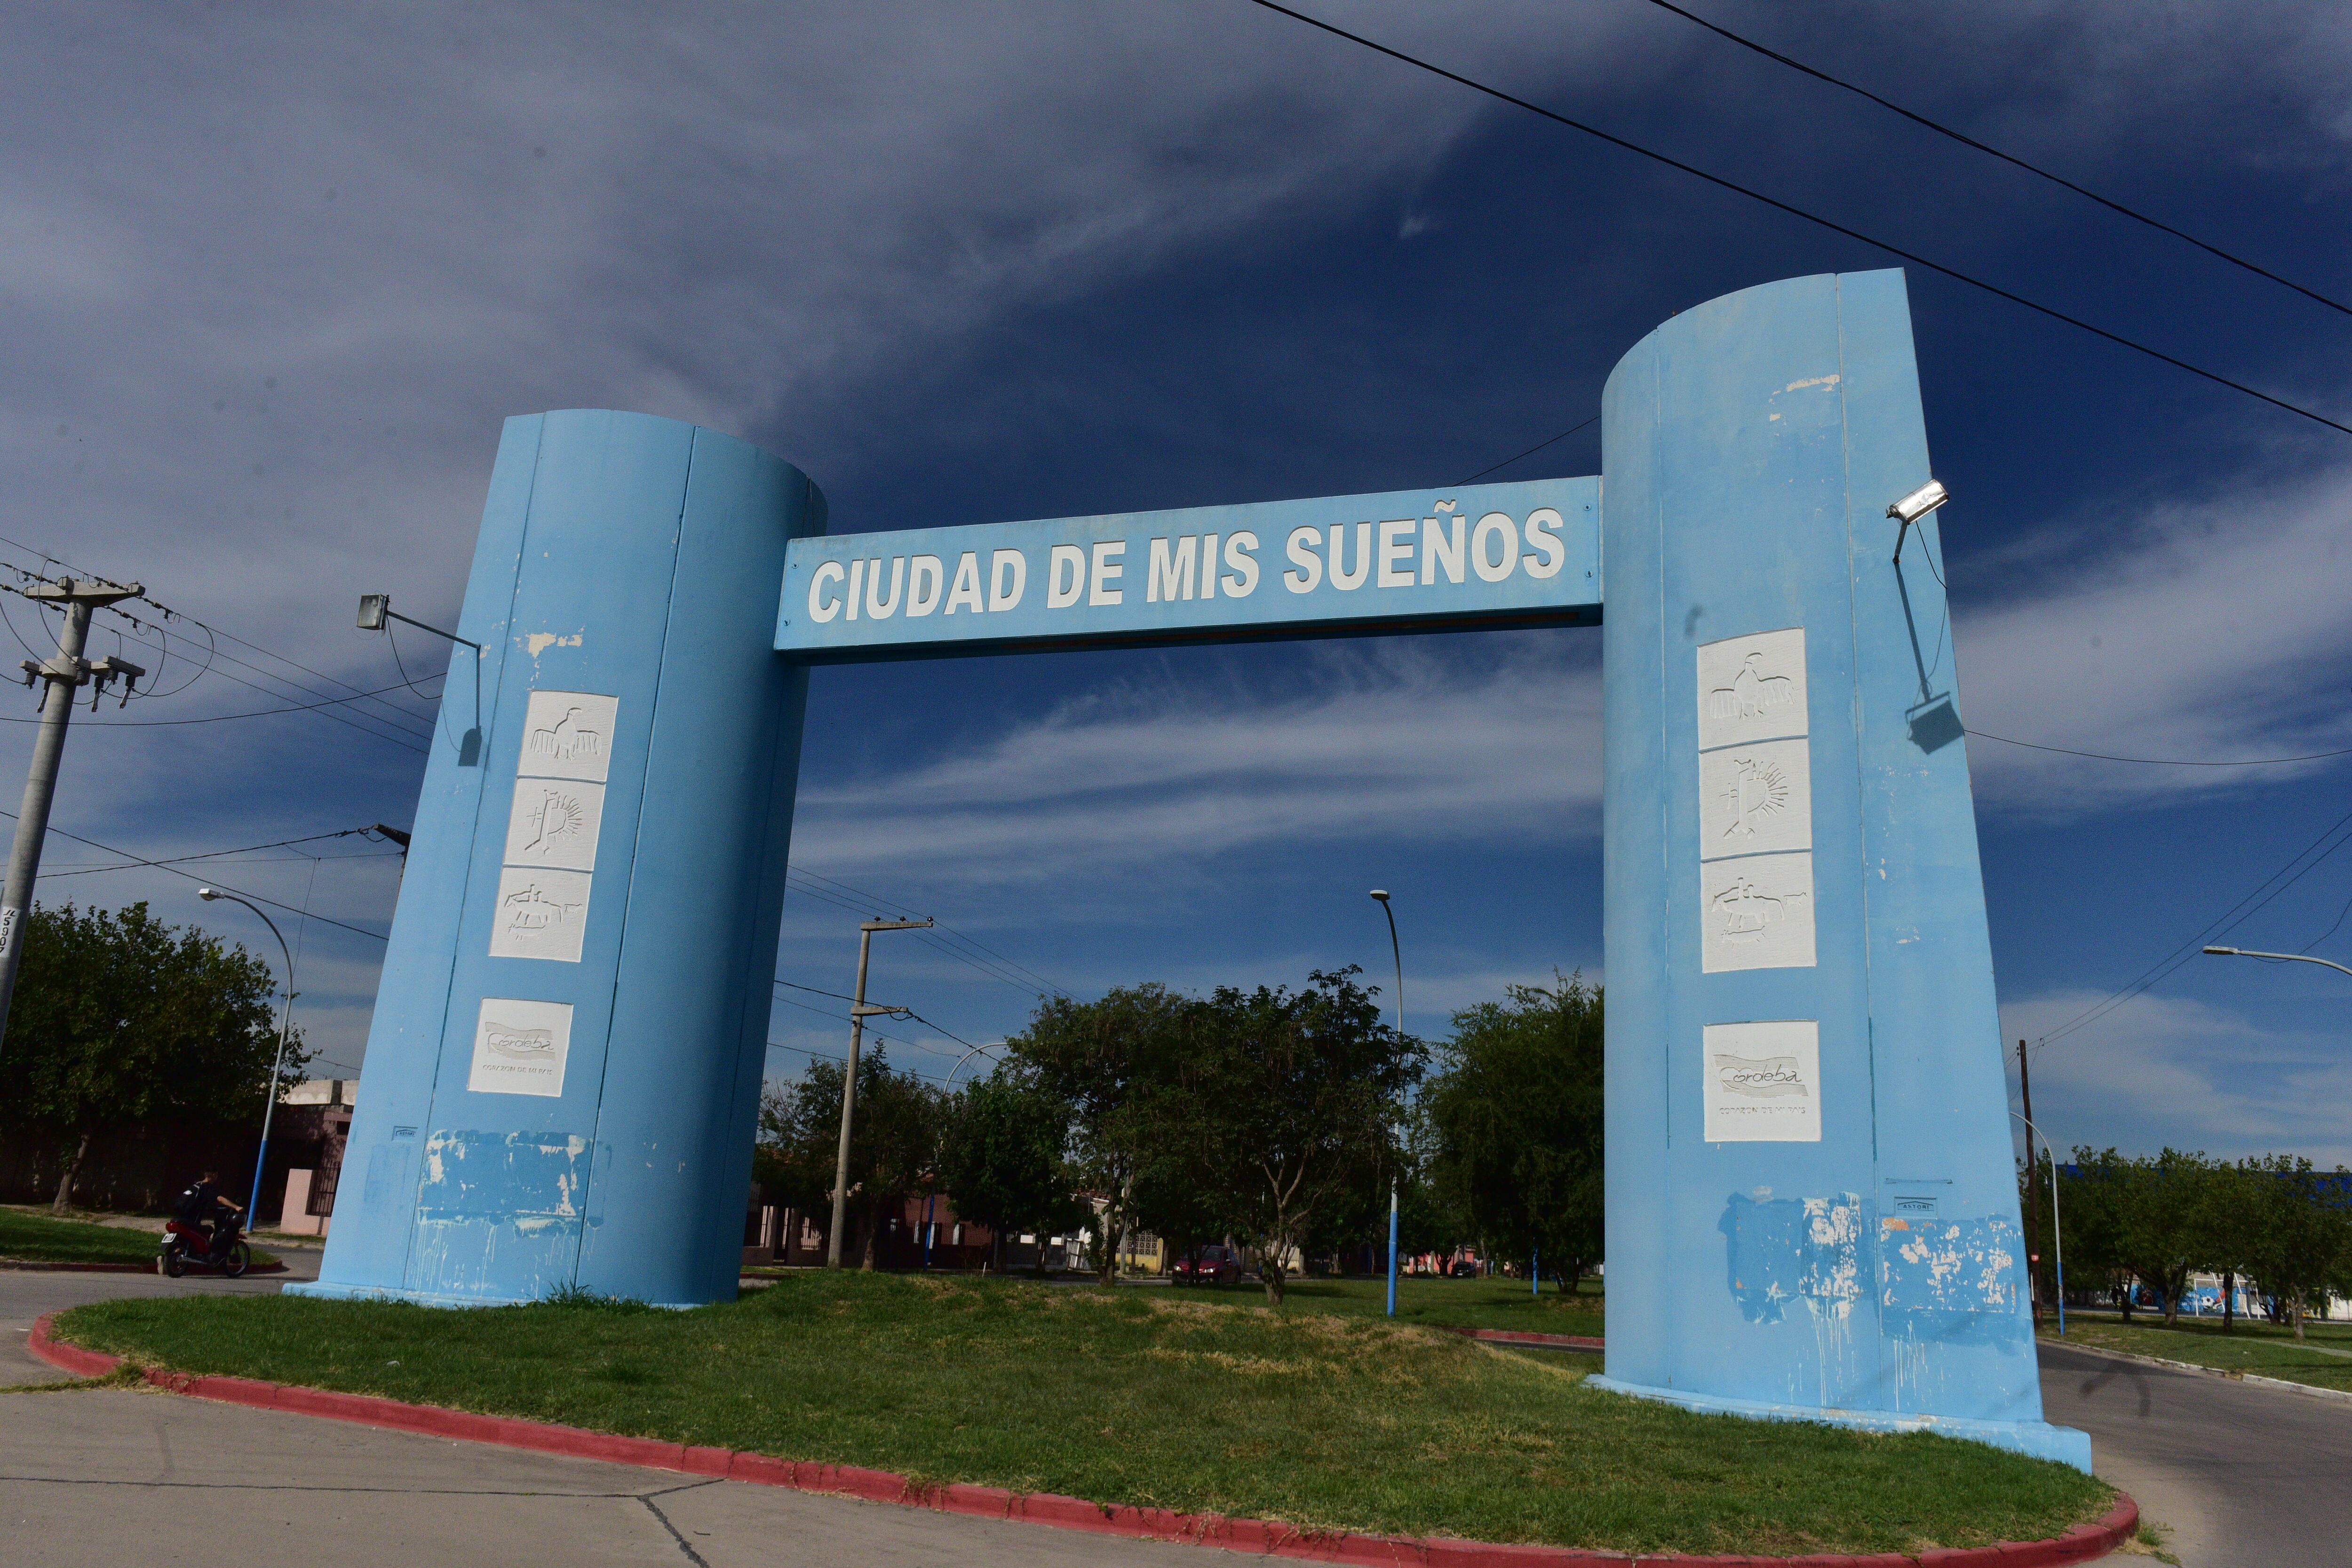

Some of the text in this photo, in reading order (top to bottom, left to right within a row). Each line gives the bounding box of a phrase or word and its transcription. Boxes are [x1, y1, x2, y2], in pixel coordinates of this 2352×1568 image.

[809, 499, 1565, 623] CIUDAD DE MIS SUEÑOS
